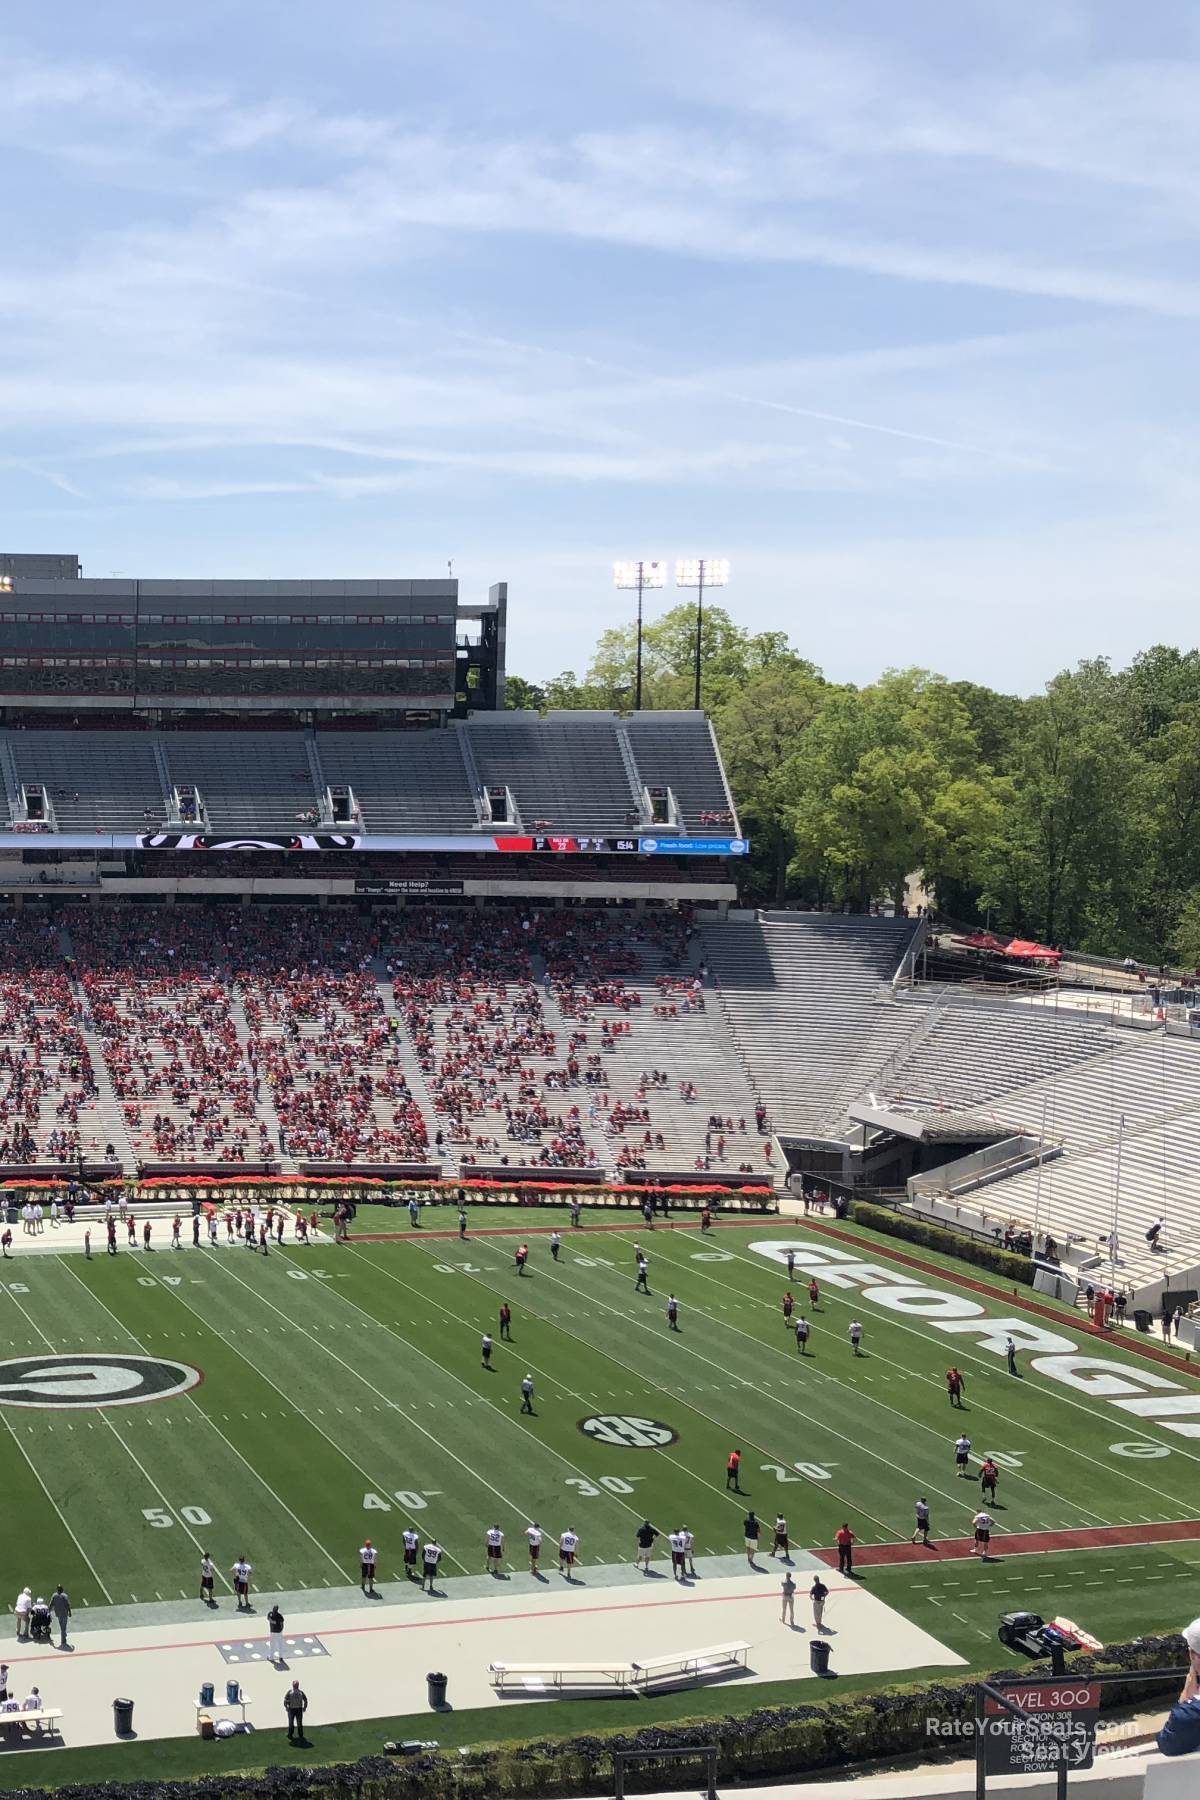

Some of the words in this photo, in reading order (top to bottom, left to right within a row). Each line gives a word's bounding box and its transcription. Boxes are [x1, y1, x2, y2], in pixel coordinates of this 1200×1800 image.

[286, 1270, 334, 1281] 30
[432, 1262, 480, 1273] 20
[136, 1276, 183, 1287] 40
[748, 1241, 1200, 1438] GEORGI
[582, 1416, 673, 1446] SEC
[760, 1461, 832, 1483] 20
[565, 1475, 635, 1496] 30
[362, 1490, 428, 1512] 40
[141, 1506, 212, 1528] 50
[1050, 1689, 1090, 1706] 300
[1024, 1762, 1047, 1771] ROW
